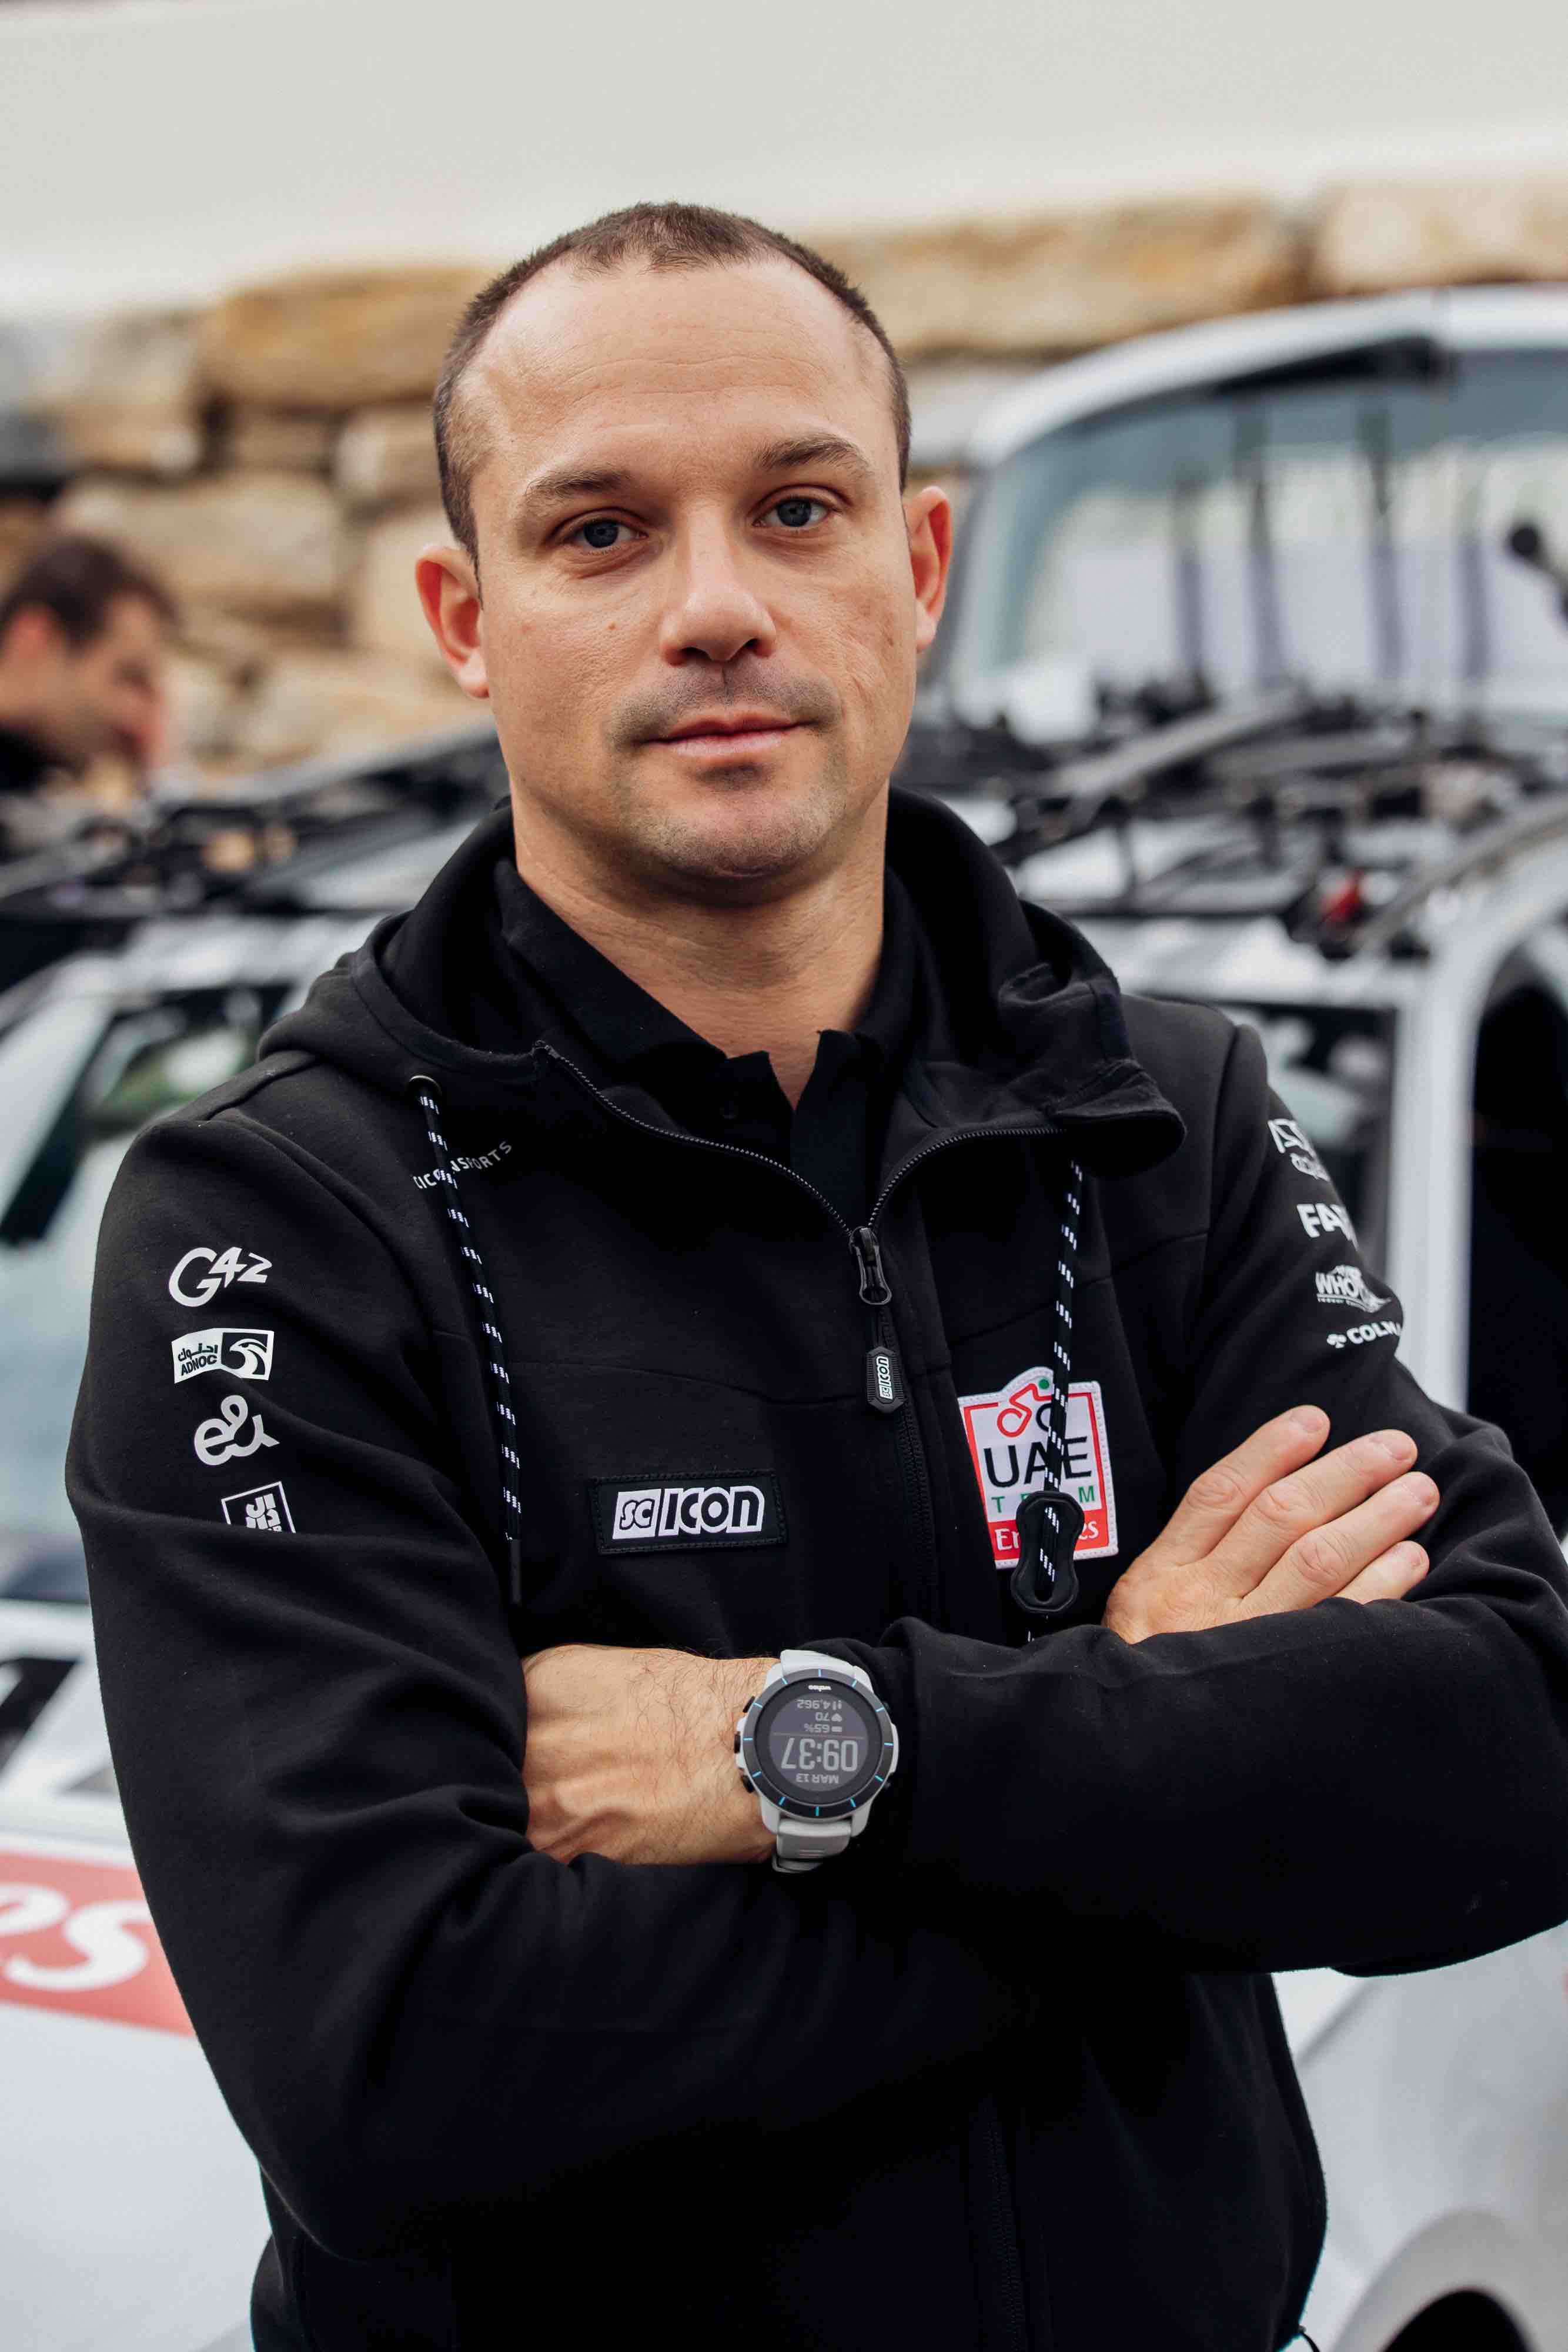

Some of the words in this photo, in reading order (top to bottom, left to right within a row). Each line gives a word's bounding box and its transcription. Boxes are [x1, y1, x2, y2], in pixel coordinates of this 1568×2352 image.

[169, 1247, 272, 1307] G42
[181, 1354, 218, 1376] ADNOC
[984, 1436, 1092, 1488] UAE
[991, 1485, 1095, 1514] TM
[804, 1723, 830, 1732] 65%
[815, 1712, 830, 1721] 70
[781, 1738, 858, 1772] 09:37
[795, 1773, 810, 1782] 13
[812, 1773, 839, 1784] MAR
